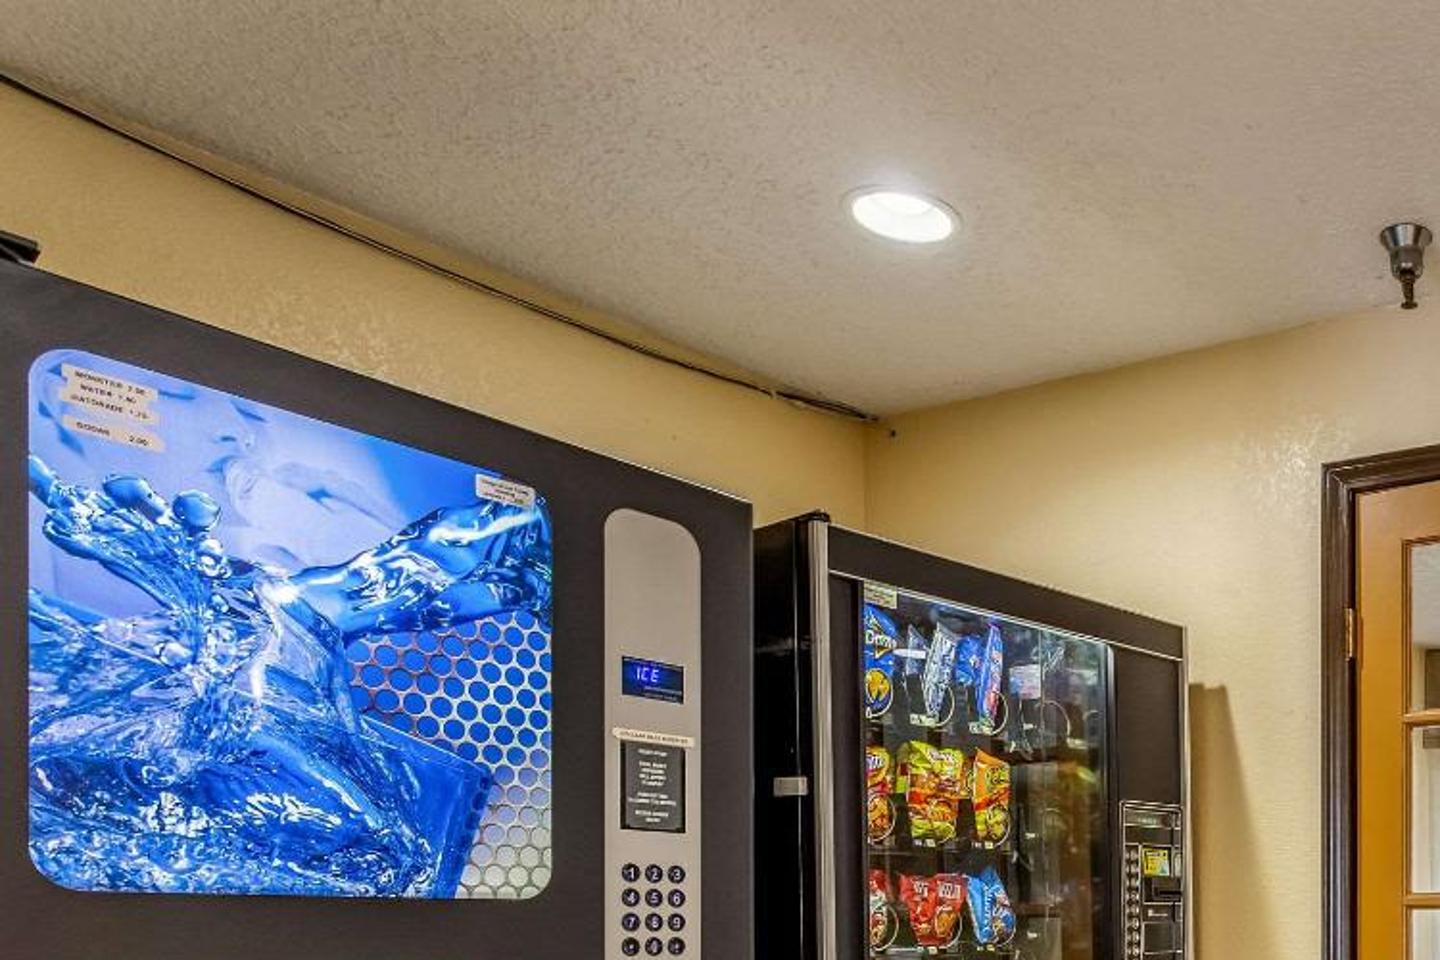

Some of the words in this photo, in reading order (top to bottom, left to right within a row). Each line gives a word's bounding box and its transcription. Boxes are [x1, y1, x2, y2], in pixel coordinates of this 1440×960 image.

[636, 667, 659, 682] ICE
[649, 891, 659, 903] 5
[673, 891, 681, 905] 6
